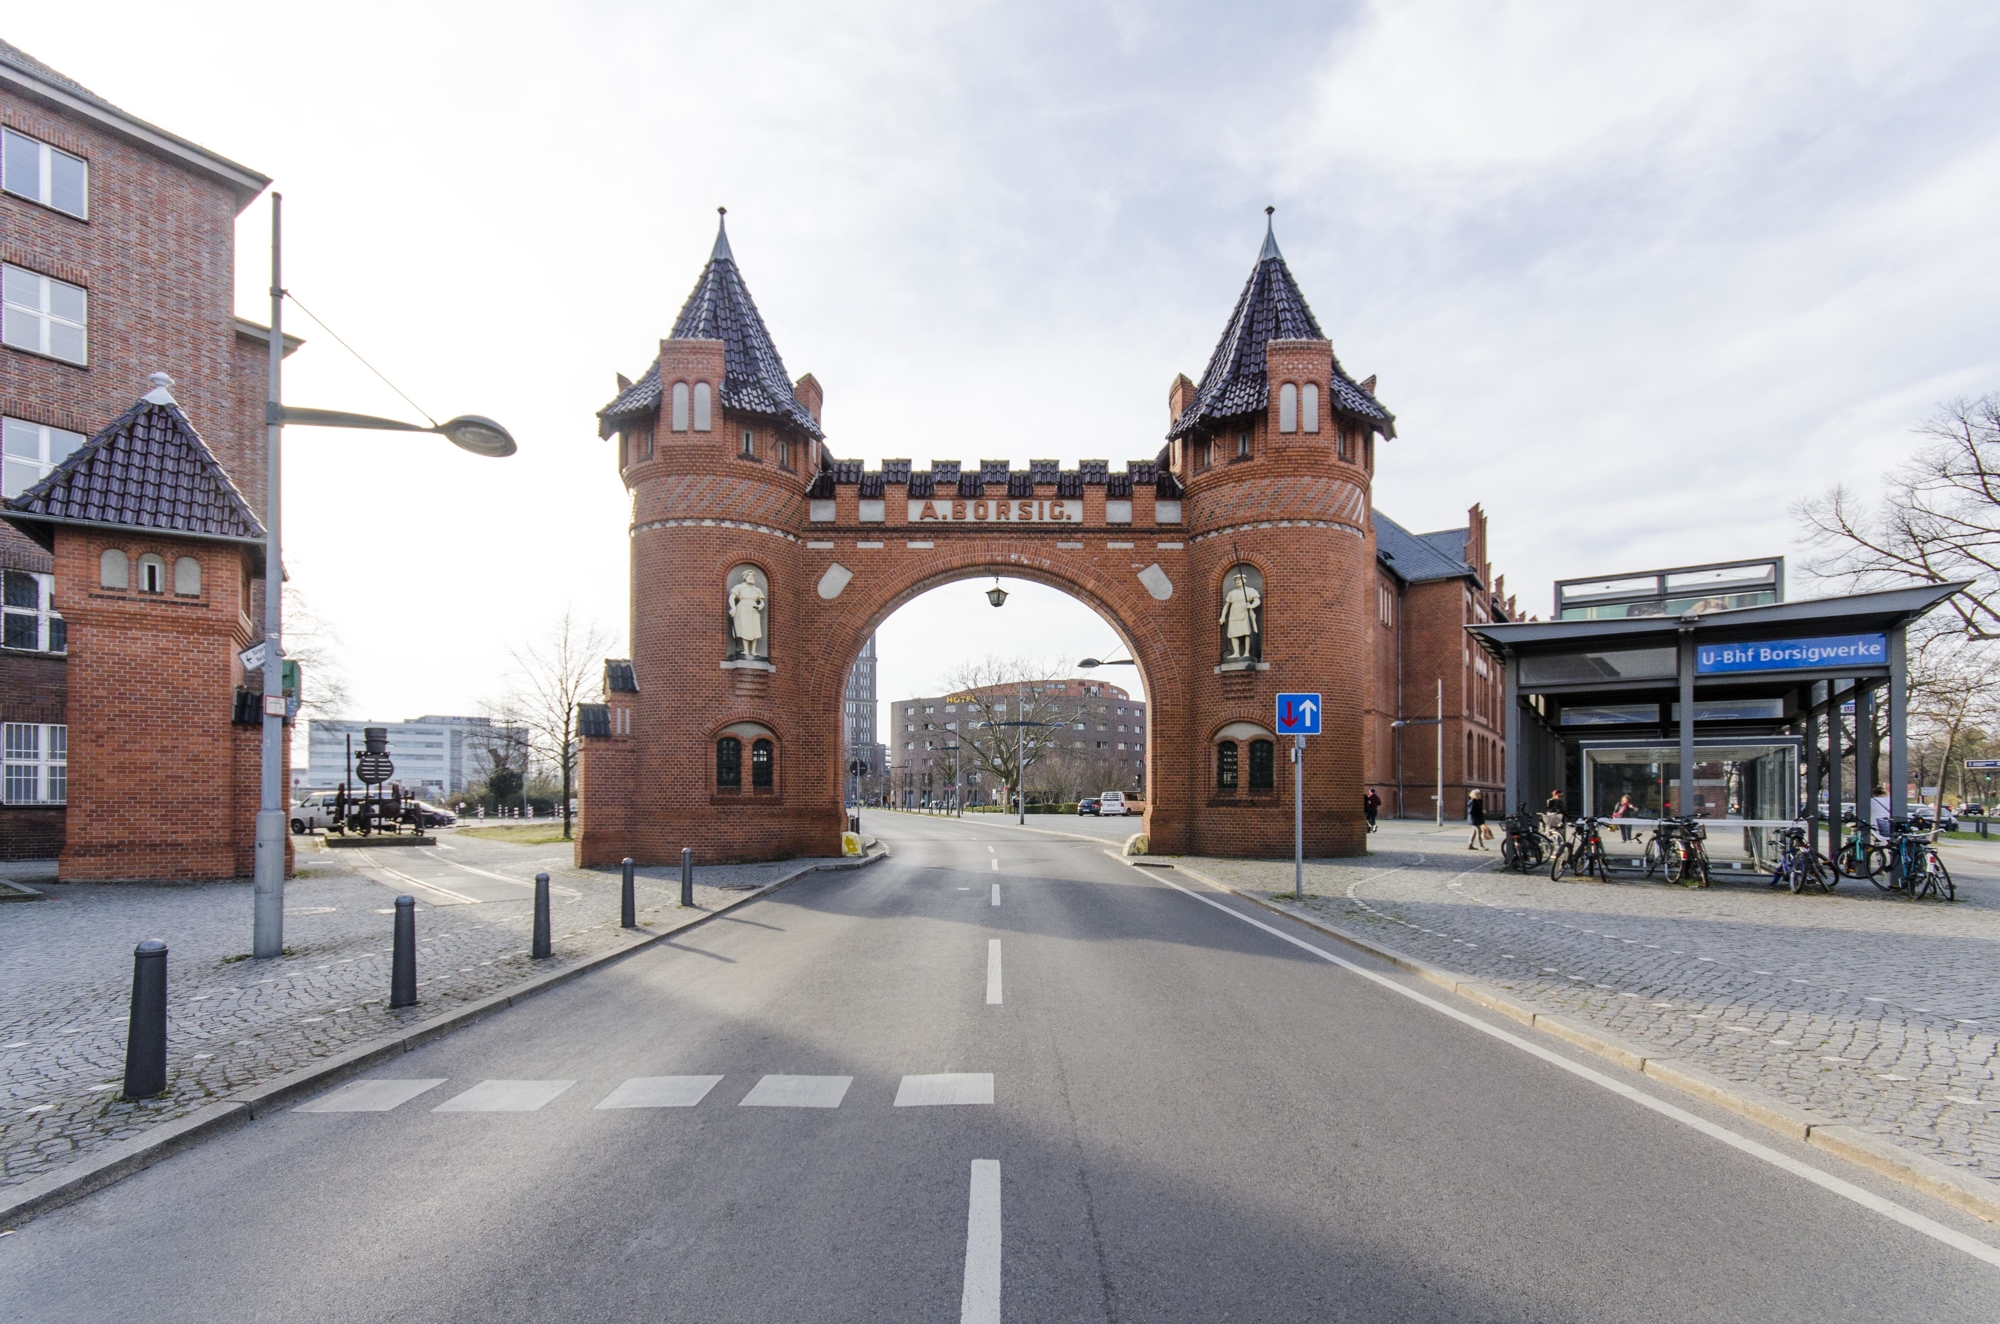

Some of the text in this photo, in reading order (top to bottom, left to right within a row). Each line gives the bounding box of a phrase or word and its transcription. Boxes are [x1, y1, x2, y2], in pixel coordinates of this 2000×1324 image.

[1702, 641, 1881, 665] U-Bhf Borsigwerke
[946, 695, 977, 704] HOTEL
